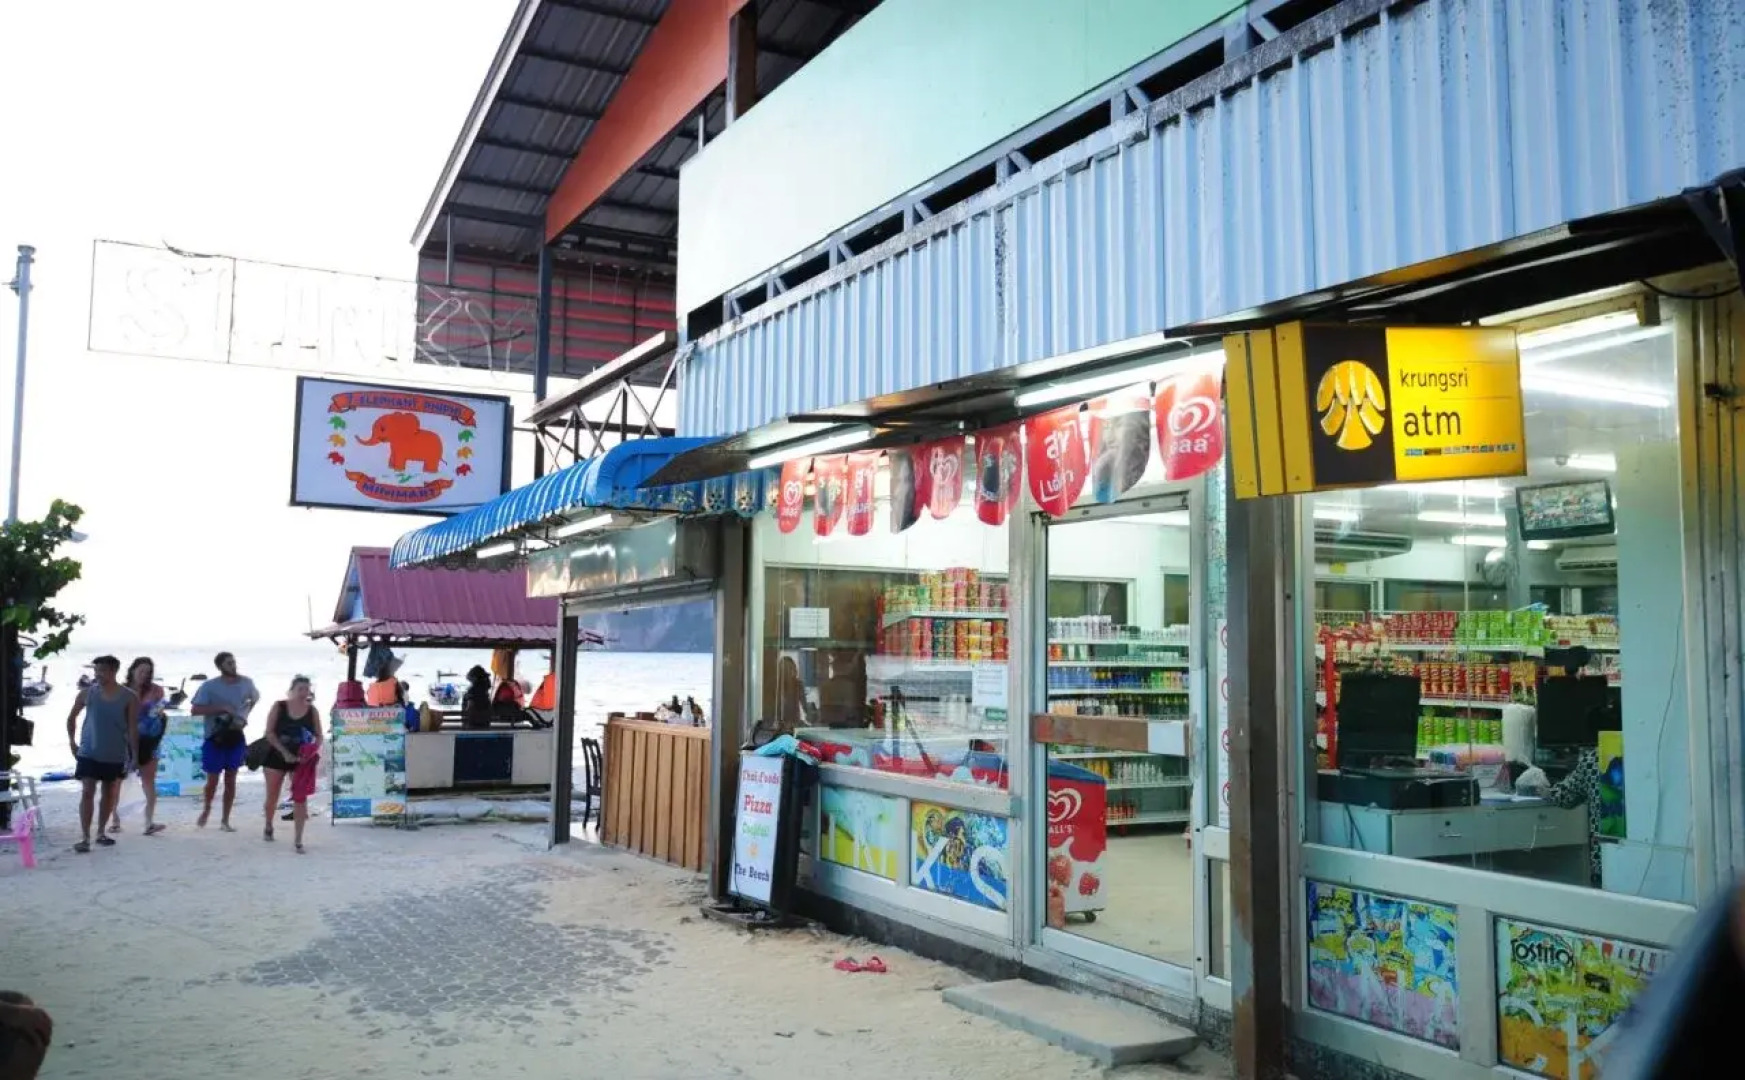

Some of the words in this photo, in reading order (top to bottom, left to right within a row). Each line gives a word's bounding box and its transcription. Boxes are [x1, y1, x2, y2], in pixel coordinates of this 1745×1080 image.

[1399, 367, 1468, 393] krungsri
[1403, 405, 1461, 437] atm
[363, 482, 435, 498] MINIMART
[743, 794, 772, 816] Pizza
[1047, 824, 1073, 834] ALL'S
[749, 866, 770, 882] Beach
